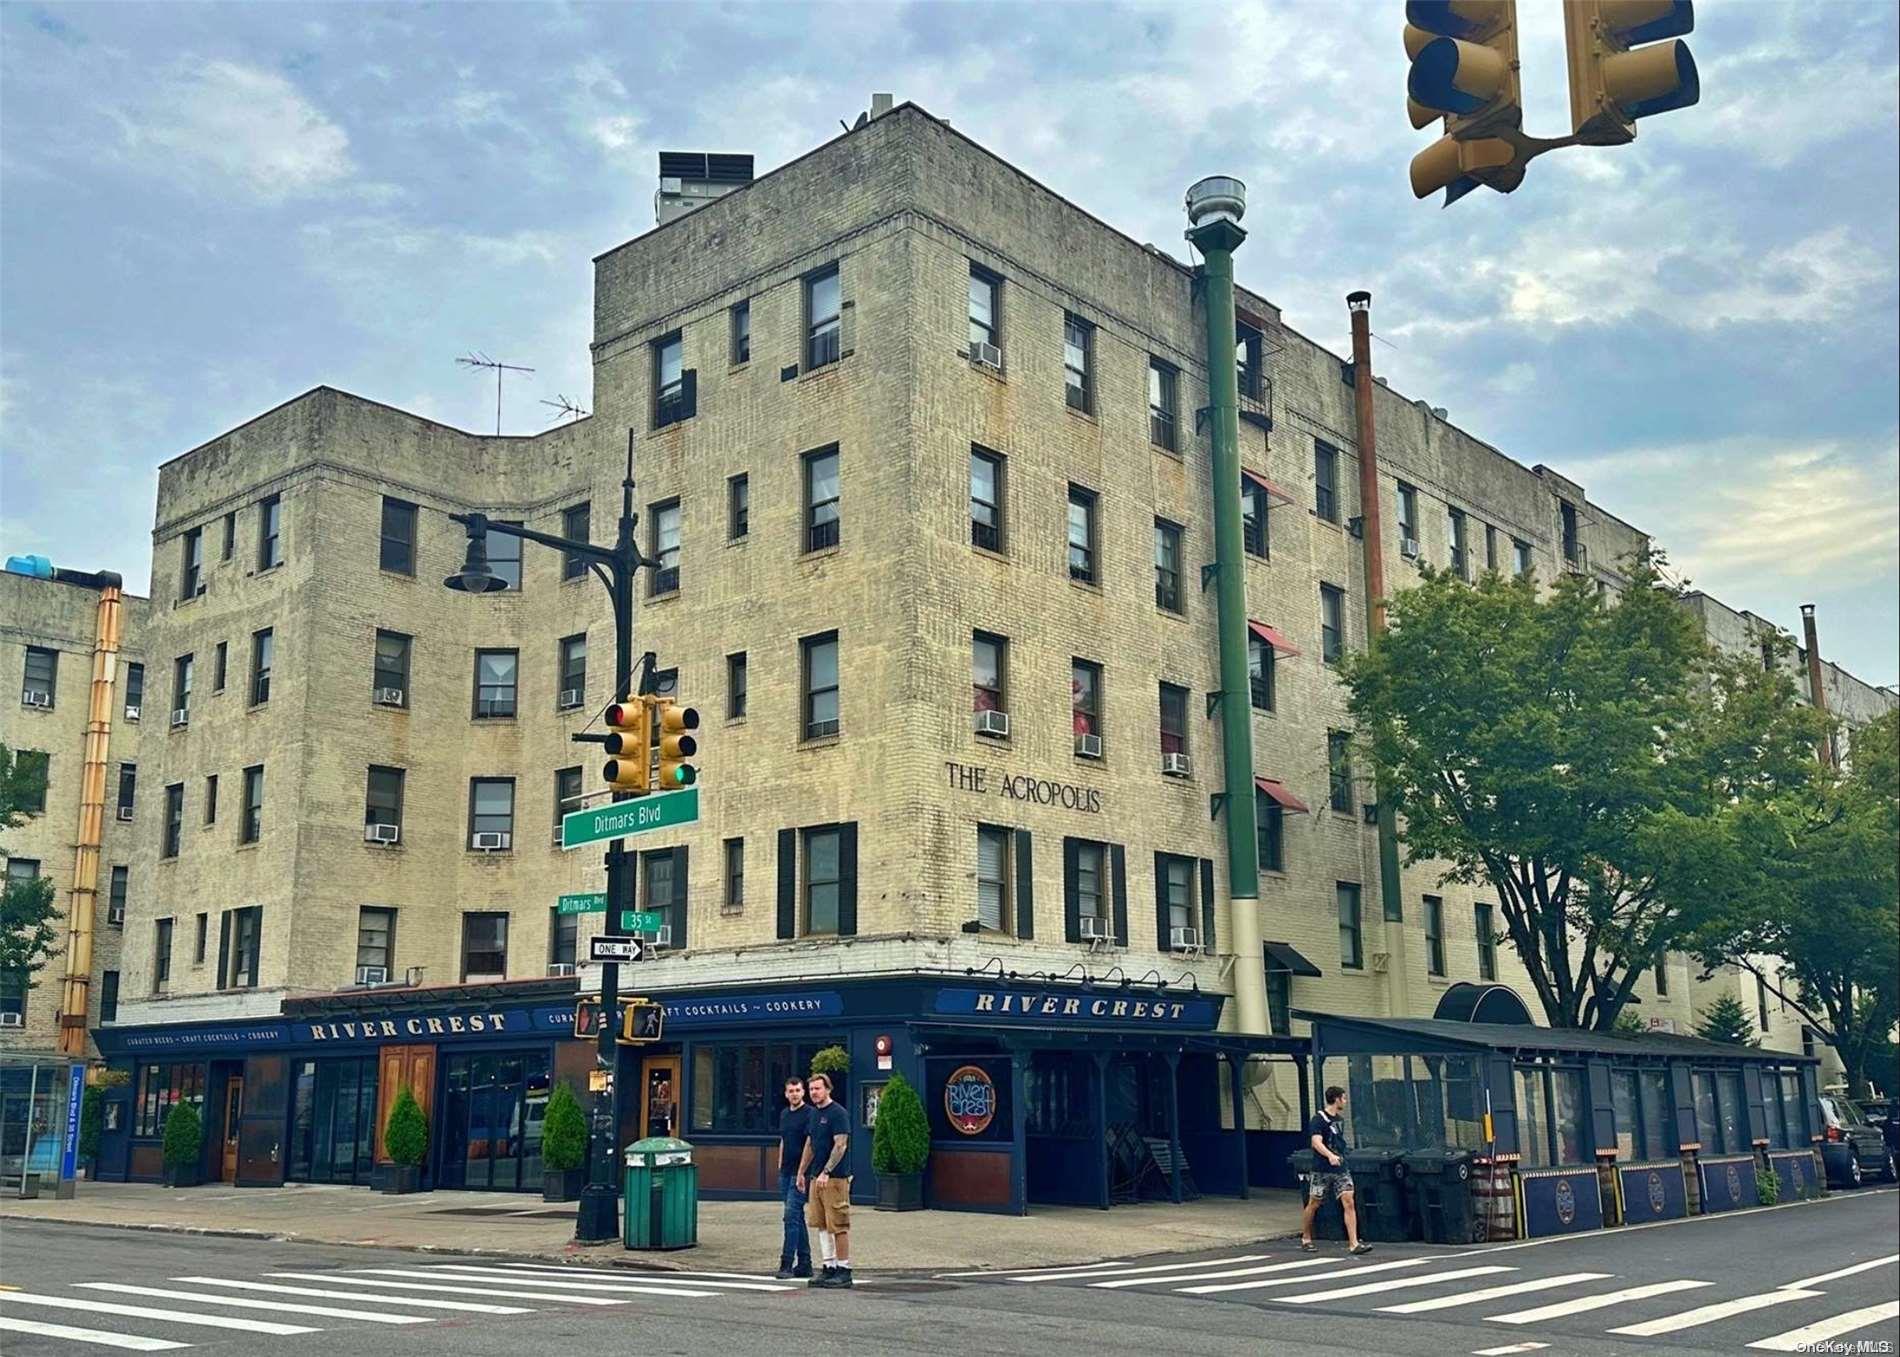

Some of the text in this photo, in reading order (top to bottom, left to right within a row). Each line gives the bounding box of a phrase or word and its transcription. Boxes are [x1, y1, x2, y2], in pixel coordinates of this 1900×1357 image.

[945, 762, 1101, 814] THE ACROPOLIS
[594, 803, 661, 834] Ditmars Blvd
[562, 898, 591, 911] Ditmars
[631, 914, 642, 928] 35
[598, 944, 637, 955] ONE WAY
[685, 1003, 748, 1016] COCKTAILS
[766, 1000, 821, 1012] COOKERY
[975, 994, 1185, 1019] RIVER CREST
[310, 1014, 505, 1040] RIVER CREST
[182, 1034, 201, 1043] CRAFT
[203, 1033, 239, 1043] COCKTAILS
[248, 1031, 279, 1040] COOKERY
